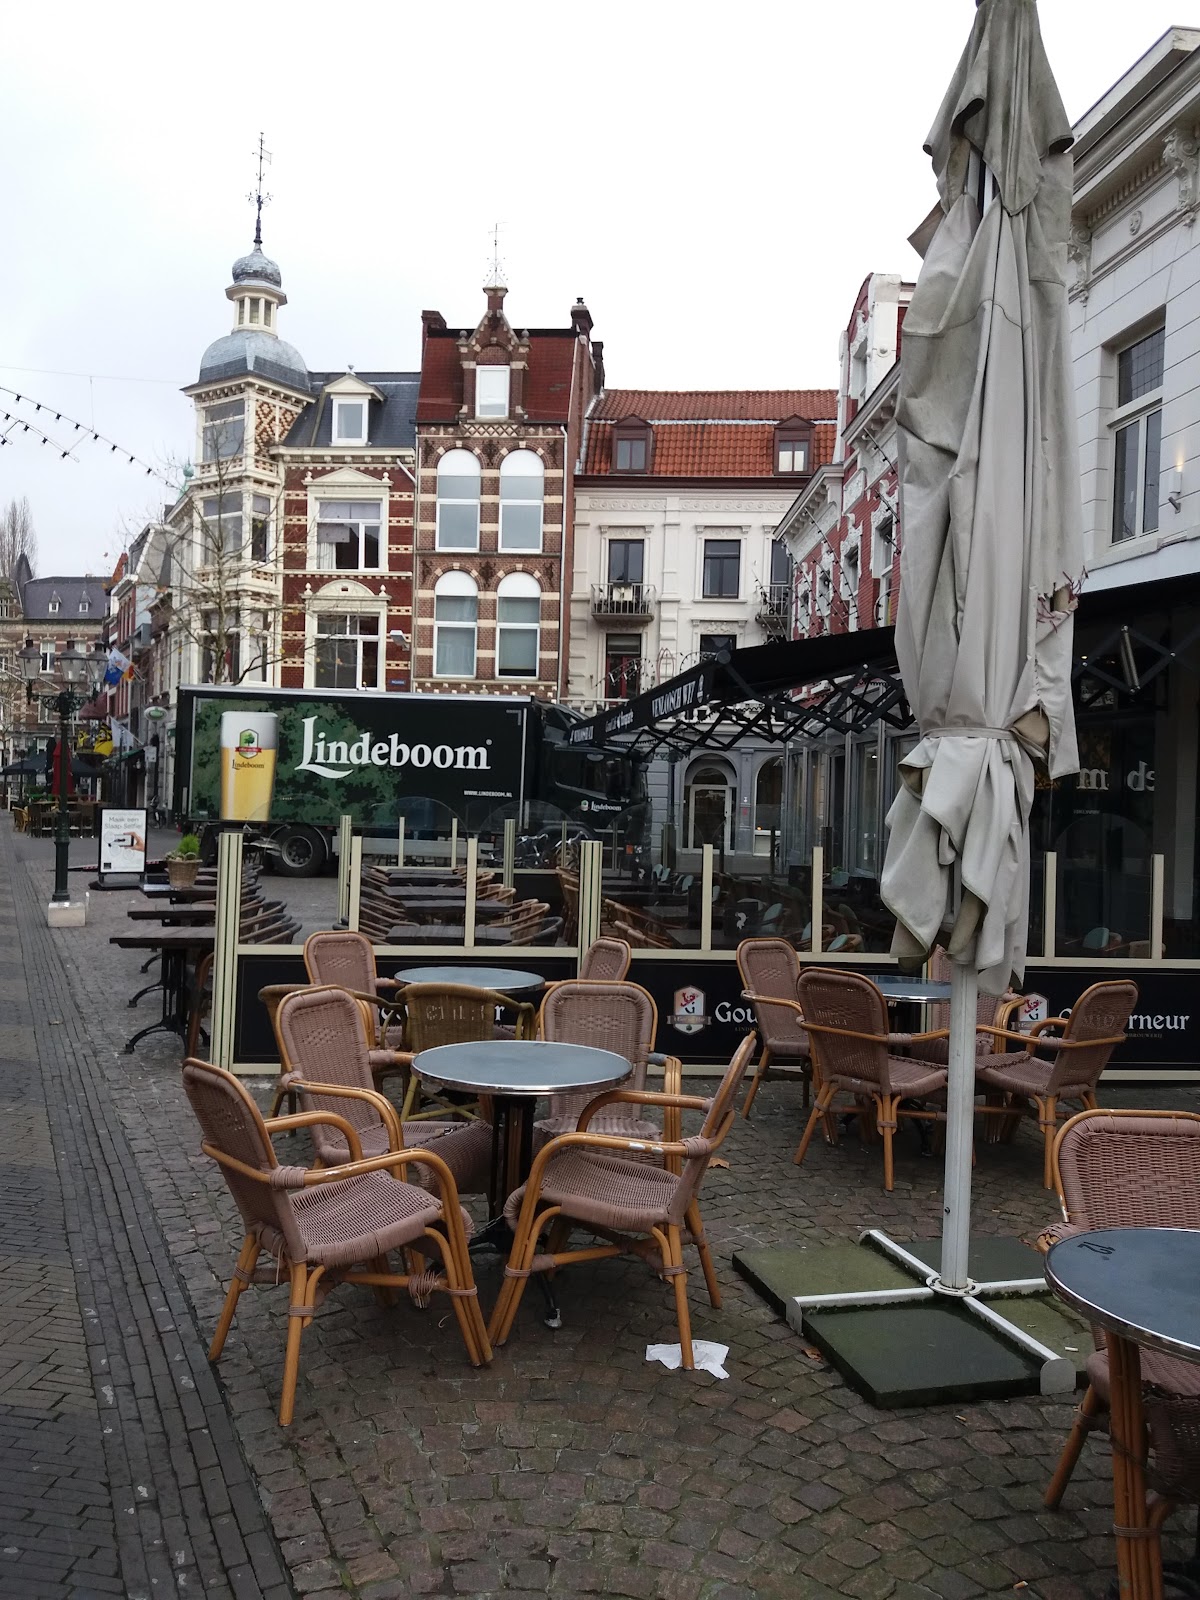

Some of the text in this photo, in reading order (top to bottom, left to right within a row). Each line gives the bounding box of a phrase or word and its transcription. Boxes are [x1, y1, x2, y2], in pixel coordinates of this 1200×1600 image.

[294, 715, 491, 778] Lindeboom
[232, 759, 265, 770] Lindeboom
[591, 800, 622, 812] Lindeboom
